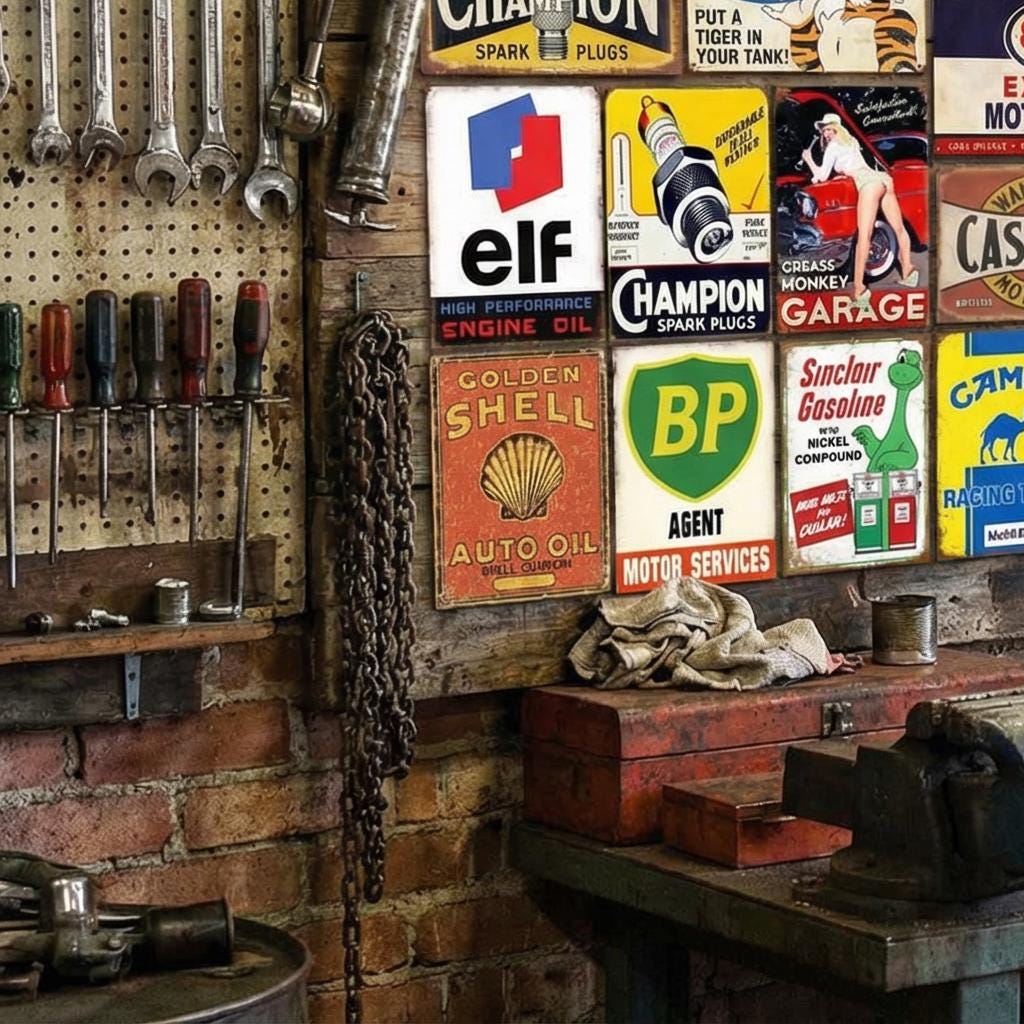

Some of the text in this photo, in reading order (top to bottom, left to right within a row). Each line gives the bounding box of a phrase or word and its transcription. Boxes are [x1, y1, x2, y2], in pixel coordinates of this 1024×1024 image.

[695, 9, 742, 25] PUT A
[695, 29, 762, 45] TIGER IN
[476, 44, 628, 60] SPARK PLUGS
[696, 49, 789, 65] YOUR TANK!
[461, 220, 572, 286] elf
[781, 275, 849, 292] MONKEY
[440, 300, 475, 315] HIGH
[612, 269, 764, 333] CHAMPION
[781, 293, 925, 327] GARAGE
[554, 318, 592, 333] OIL
[657, 315, 756, 333] SPARK PLUGS
[458, 366, 581, 390] GOLDEN
[800, 354, 882, 388] Sinclair
[445, 391, 596, 441] SHELL
[650, 381, 748, 458] BP
[808, 436, 850, 449] NICKEL
[944, 482, 1014, 508] RACING
[668, 508, 724, 539] AGENT
[449, 532, 599, 567] AUTO OIL
[623, 545, 771, 586] MOTOR SERVICES
